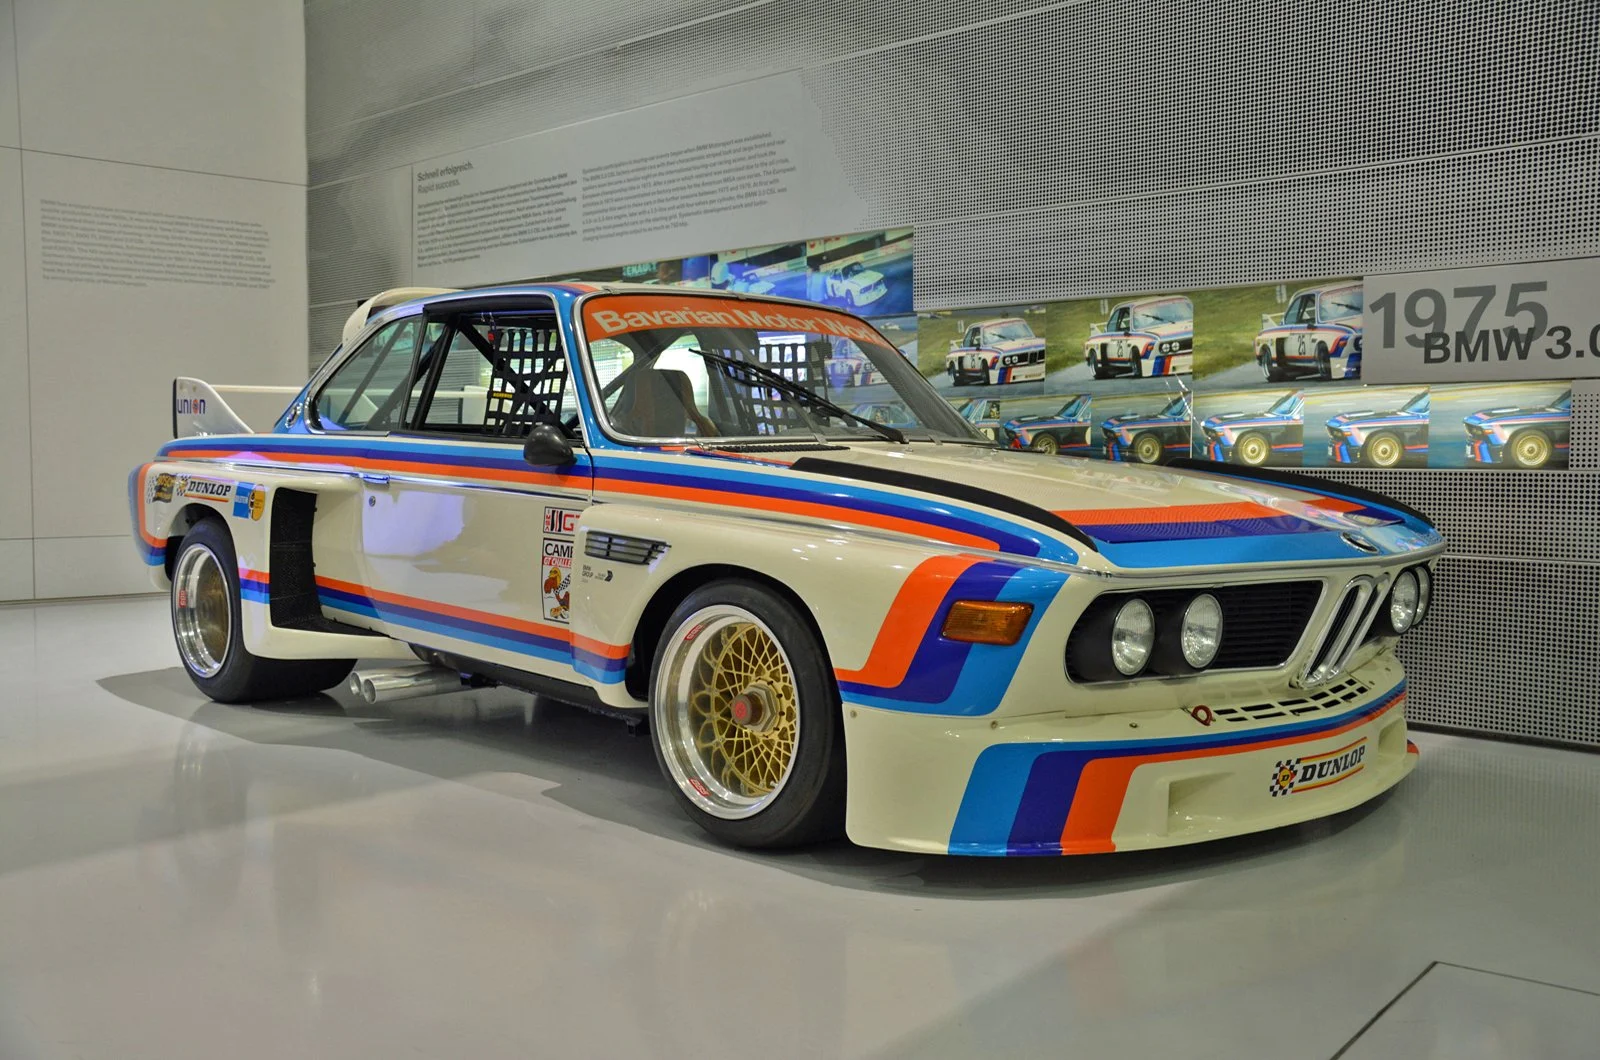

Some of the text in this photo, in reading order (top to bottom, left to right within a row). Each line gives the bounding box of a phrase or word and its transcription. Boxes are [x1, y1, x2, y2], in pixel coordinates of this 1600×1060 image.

[417, 168, 439, 182] Schnell
[591, 305, 741, 334] Bavarian
[732, 308, 818, 332] Motor
[1368, 280, 1549, 350] 1975
[1424, 326, 1536, 364] BMW
[176, 398, 206, 414] union
[187, 480, 231, 496] DUNLOP
[1298, 744, 1366, 783] DUNLOP
